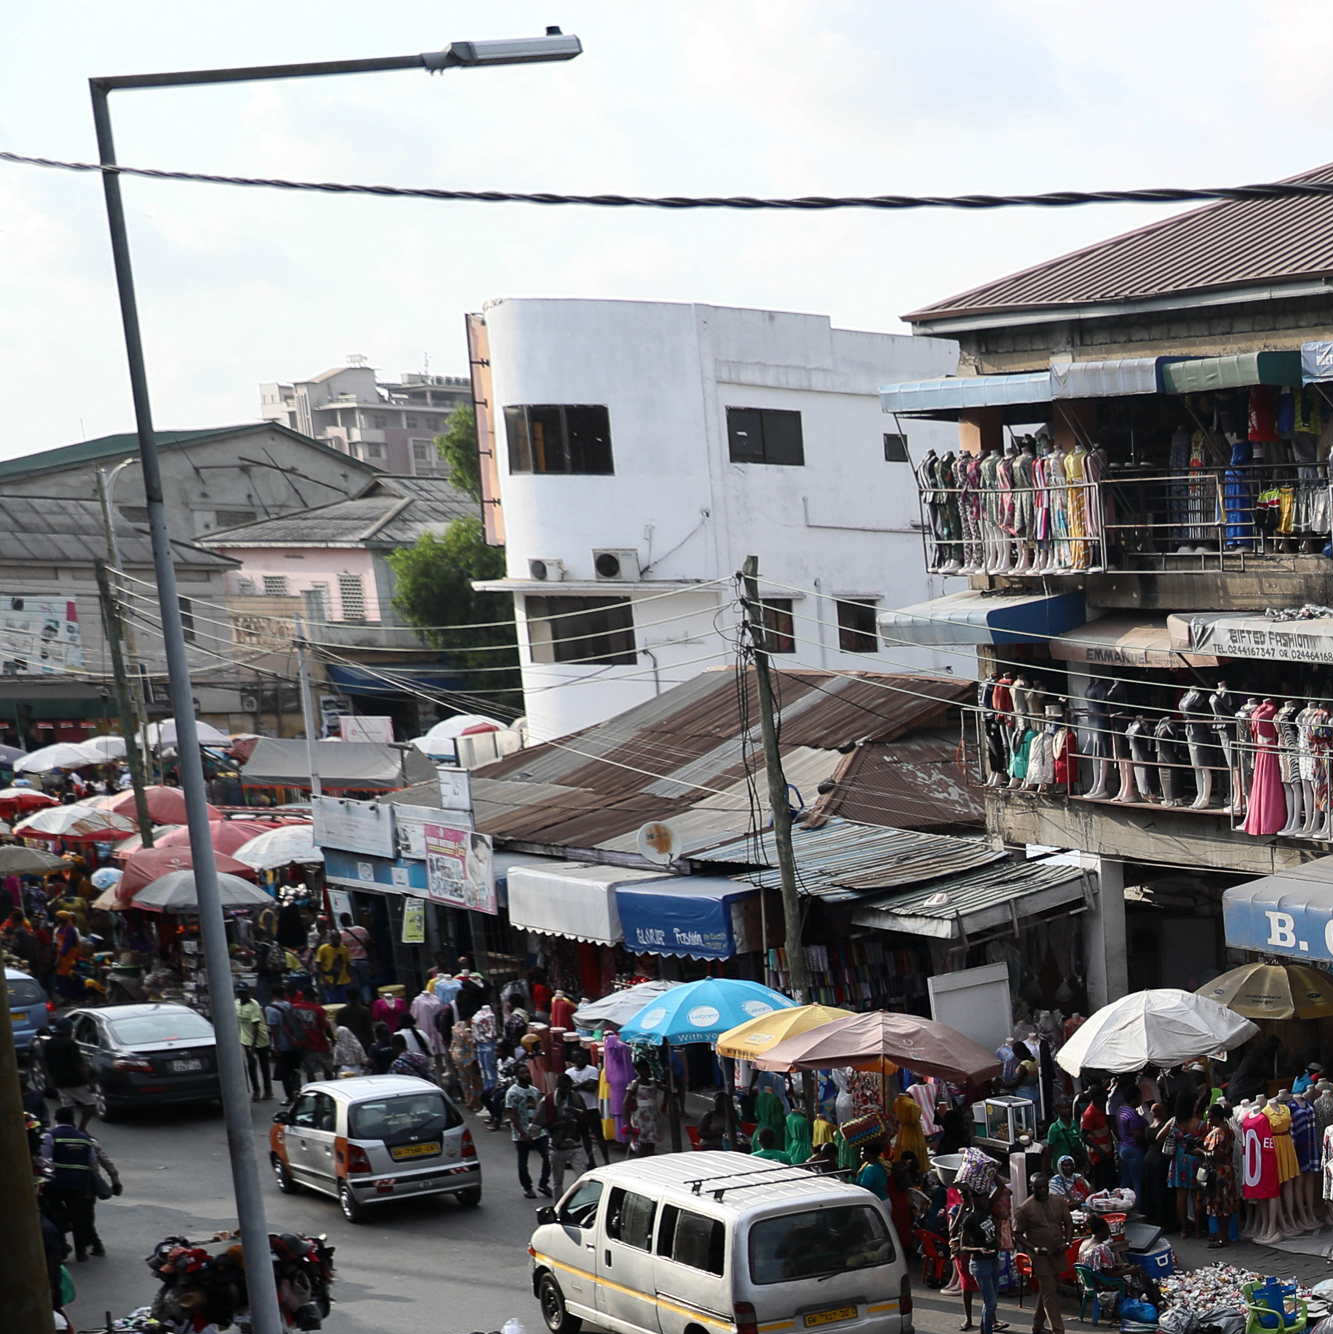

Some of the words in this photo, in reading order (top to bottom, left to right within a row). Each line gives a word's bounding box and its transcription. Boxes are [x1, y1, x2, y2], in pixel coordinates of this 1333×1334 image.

[1229, 628, 1266, 645] GIFTED
[1268, 631, 1310, 649] FASHION
[1086, 648, 1151, 665] EMMANUEL
[1264, 910, 1309, 951] B.
[677, 1033, 703, 1042] With
